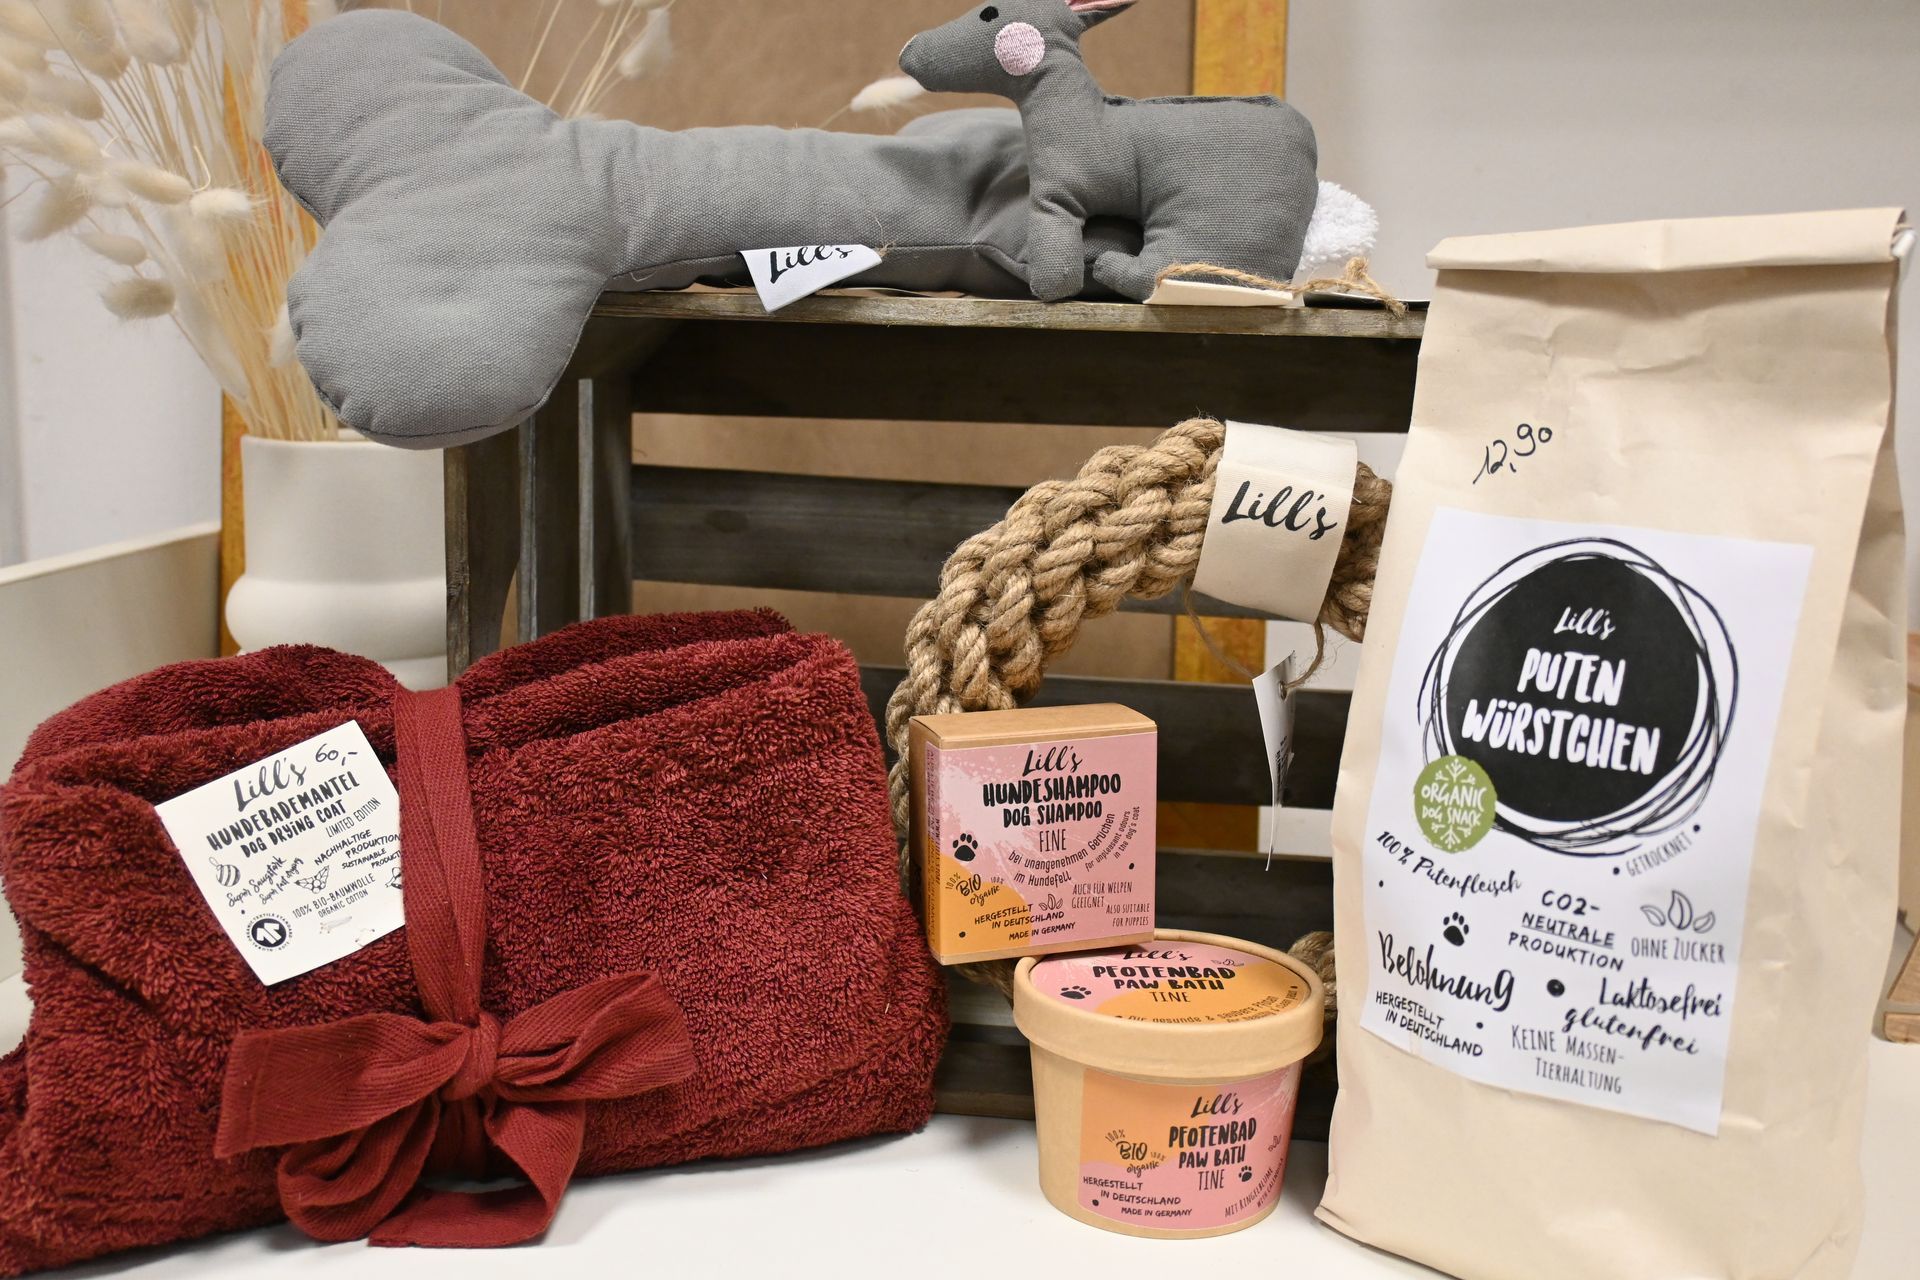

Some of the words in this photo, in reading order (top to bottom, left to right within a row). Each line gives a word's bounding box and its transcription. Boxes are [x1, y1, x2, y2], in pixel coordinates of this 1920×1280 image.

[770, 245, 853, 284] Lills
[1472, 423, 1553, 484] 12,90
[1221, 480, 1337, 541] Lill's
[1554, 606, 1616, 640] Lill's
[1517, 647, 1626, 706] PUTEN
[1462, 698, 1660, 775] WÜRSTCHEN
[315, 743, 358, 766] 60,-
[1022, 745, 1083, 778] Lill's
[234, 757, 307, 812] Lill's
[983, 773, 1122, 808] HUNDESHAMPOO
[1421, 782, 1487, 812] ORGANIC
[206, 771, 360, 851] HUNDEBADEMANTEL
[325, 816, 355, 838] LIMITED
[353, 797, 382, 822] EDITION
[1003, 805, 1031, 829] DOG
[1037, 800, 1103, 825] SHAMPOO
[1422, 804, 1443, 823] DOG
[1447, 807, 1482, 826] SNACK
[240, 836, 267, 858] DOG
[316, 799, 347, 823] COAT
[1039, 828, 1067, 853] FINE
[1085, 860, 1095, 872] for
[1096, 833, 1122, 863] unpleasant
[1120, 810, 1131, 832] odours
[1119, 841, 1129, 852] the
[1132, 806, 1140, 821] coat
[314, 829, 372, 866] NACHHALTIGE
[341, 848, 387, 869] SUSTAINABLE
[345, 833, 401, 859] PRODUKTION
[1008, 850, 1022, 865] bei
[1024, 848, 1088, 873] unangenehmen
[1626, 831, 1692, 877] GETROCKNET
[956, 873, 981, 896] BIO
[1013, 870, 1025, 884] im
[1028, 870, 1071, 888] Hundefell
[1072, 883, 1091, 895] AUCH
[1107, 881, 1133, 894] WELPEN
[1412, 856, 1521, 898] Putenfleisch
[292, 903, 313, 919] 100%
[312, 872, 376, 910] BIO-BAUMWOLLE
[317, 900, 346, 919] ORGANIC
[345, 888, 369, 905] COTTON
[1071, 896, 1105, 909] GEEIGNET
[1106, 904, 1121, 914] ALSO
[1122, 903, 1150, 913] SUITABLE
[1541, 890, 1600, 915] CO2-
[974, 904, 1034, 925] HERGESTELLT
[992, 920, 1001, 929] IN
[1004, 911, 1065, 928] DEUTSCHLAND
[1112, 917, 1124, 927] FOR
[1125, 916, 1149, 926] PUPPIES
[1008, 930, 1029, 941] MADE
[1031, 928, 1040, 937] IN
[1041, 922, 1076, 934] GERMANY
[1522, 912, 1615, 948] NEUTRALE
[1123, 949, 1193, 961] Lill's
[1508, 932, 1624, 971] PRODUKTION
[1631, 937, 1669, 960] OHNE
[1673, 937, 1726, 964] ZUCKER
[1092, 965, 1236, 980] PFOTENBAD
[1114, 979, 1159, 990] PAW
[1170, 979, 1225, 990] BATH
[1378, 930, 1515, 1012] Belohnung
[1149, 991, 1191, 1003] TINE
[1376, 991, 1445, 1030] HERGESTELLT
[1600, 977, 1722, 1020] Laktosefrei
[1385, 1009, 1398, 1024] IN
[1400, 1015, 1483, 1057] DEUTSCHLAND
[1562, 1007, 1699, 1055] glutenfrei
[1190, 1092, 1244, 1119] Lill's
[1168, 1117, 1257, 1148] PFOTENBAD
[1116, 1140, 1148, 1161] BIO
[1178, 1150, 1208, 1169] PAW
[1213, 1144, 1246, 1167] BATH
[1083, 1176, 1143, 1191] HERGESTELLT
[1198, 1169, 1225, 1191] TINE
[1100, 1190, 1110, 1198] IN
[1112, 1192, 1181, 1205] DEUTSCHLAND
[1121, 1207, 1142, 1216] MADE
[1144, 1208, 1153, 1216] IN
[1155, 1208, 1193, 1217] GERMANY
